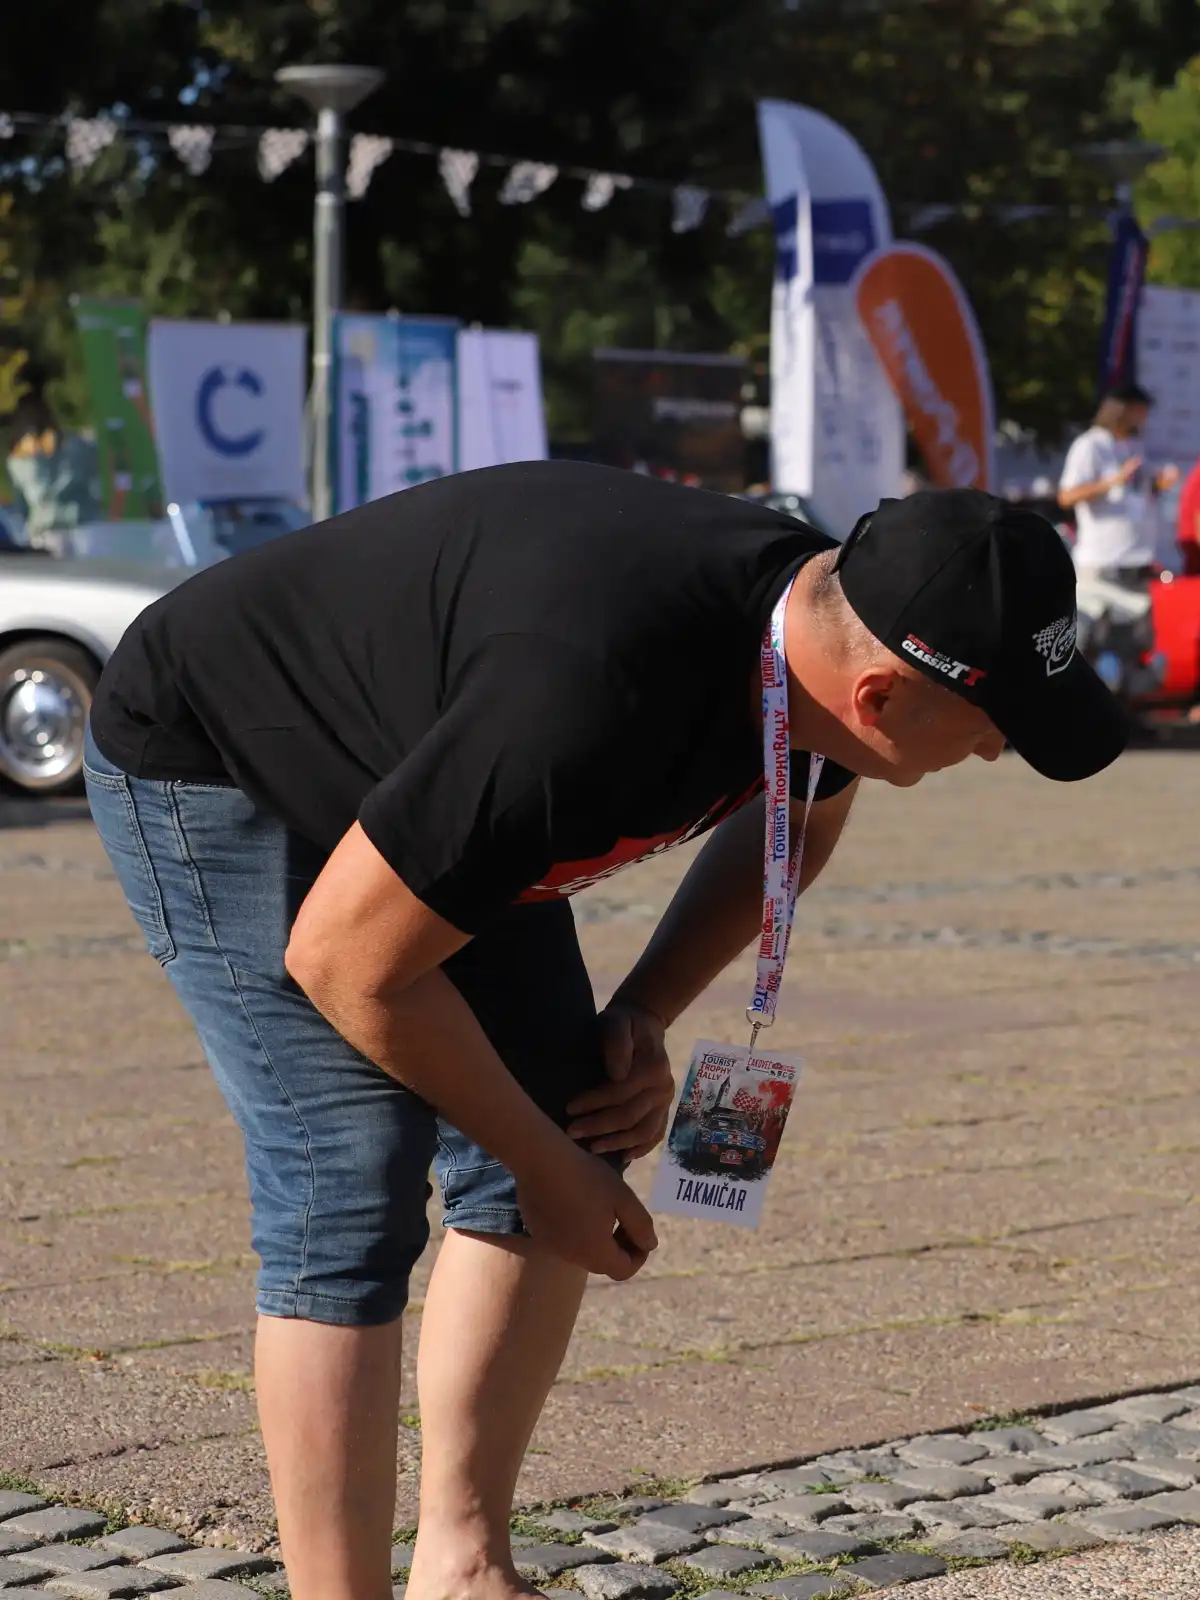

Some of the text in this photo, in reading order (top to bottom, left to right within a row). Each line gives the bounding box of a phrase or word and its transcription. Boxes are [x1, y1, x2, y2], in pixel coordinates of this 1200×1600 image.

[901, 640, 952, 674] CLASSIC
[702, 1053, 737, 1067] TOURIST
[696, 1069, 722, 1080] RALLY
[700, 1062, 731, 1074] TROPHY
[676, 1178, 747, 1211] TAKMIČAR
